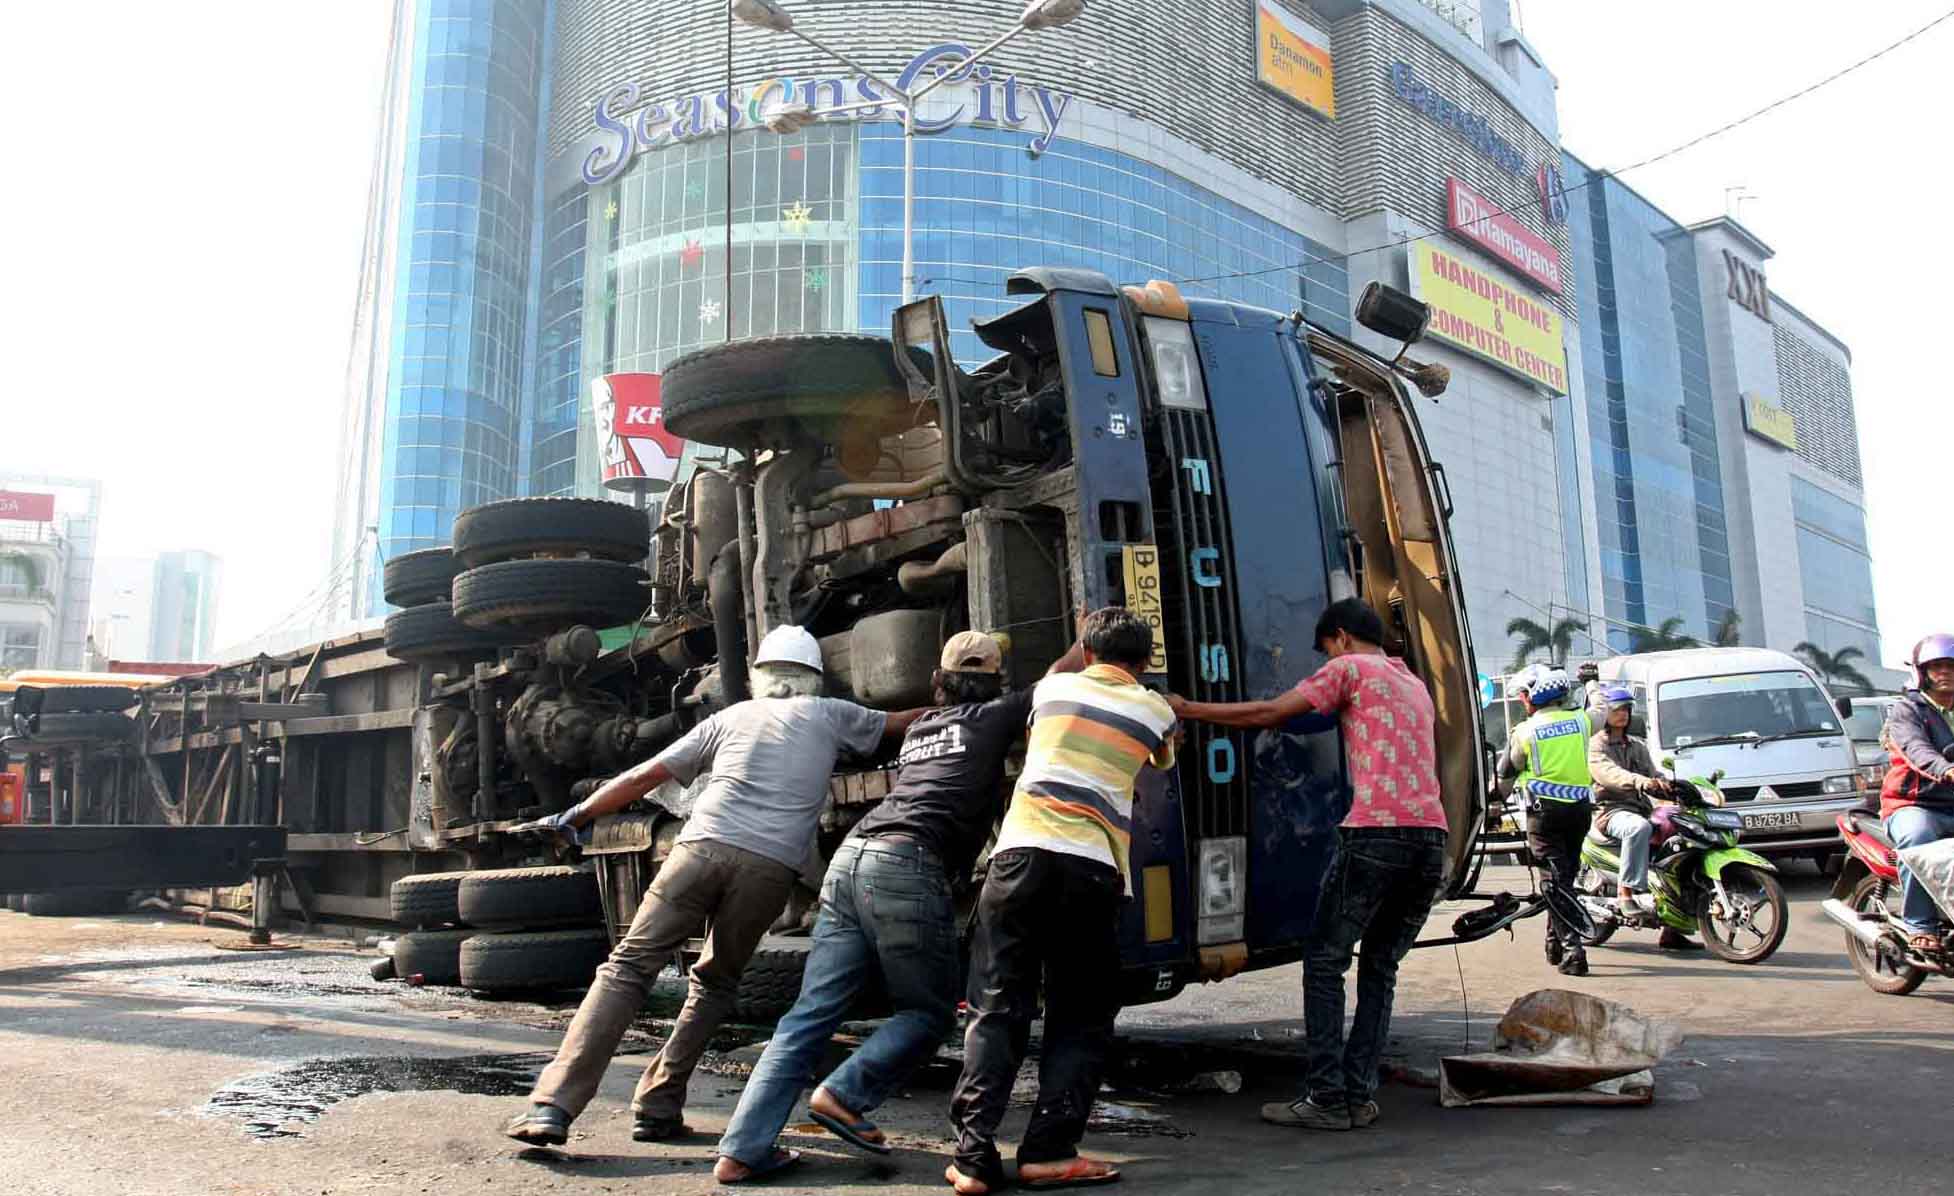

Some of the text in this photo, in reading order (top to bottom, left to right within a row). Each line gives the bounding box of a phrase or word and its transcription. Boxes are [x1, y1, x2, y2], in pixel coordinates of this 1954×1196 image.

[1270, 32, 1323, 78] Danamon
[582, 41, 1073, 184] Seasons City
[1480, 208, 1558, 282] Ramayana
[1431, 251, 1552, 334] HANDPHONE
[1722, 248, 1773, 325] XXI
[1493, 307, 1504, 334] &
[1430, 304, 1564, 391] COMPUTER CENTER
[624, 405, 663, 425] KF
[1135, 550, 1156, 569] B
[1537, 722, 1578, 739] POLISI
[1745, 815, 1753, 829] B
